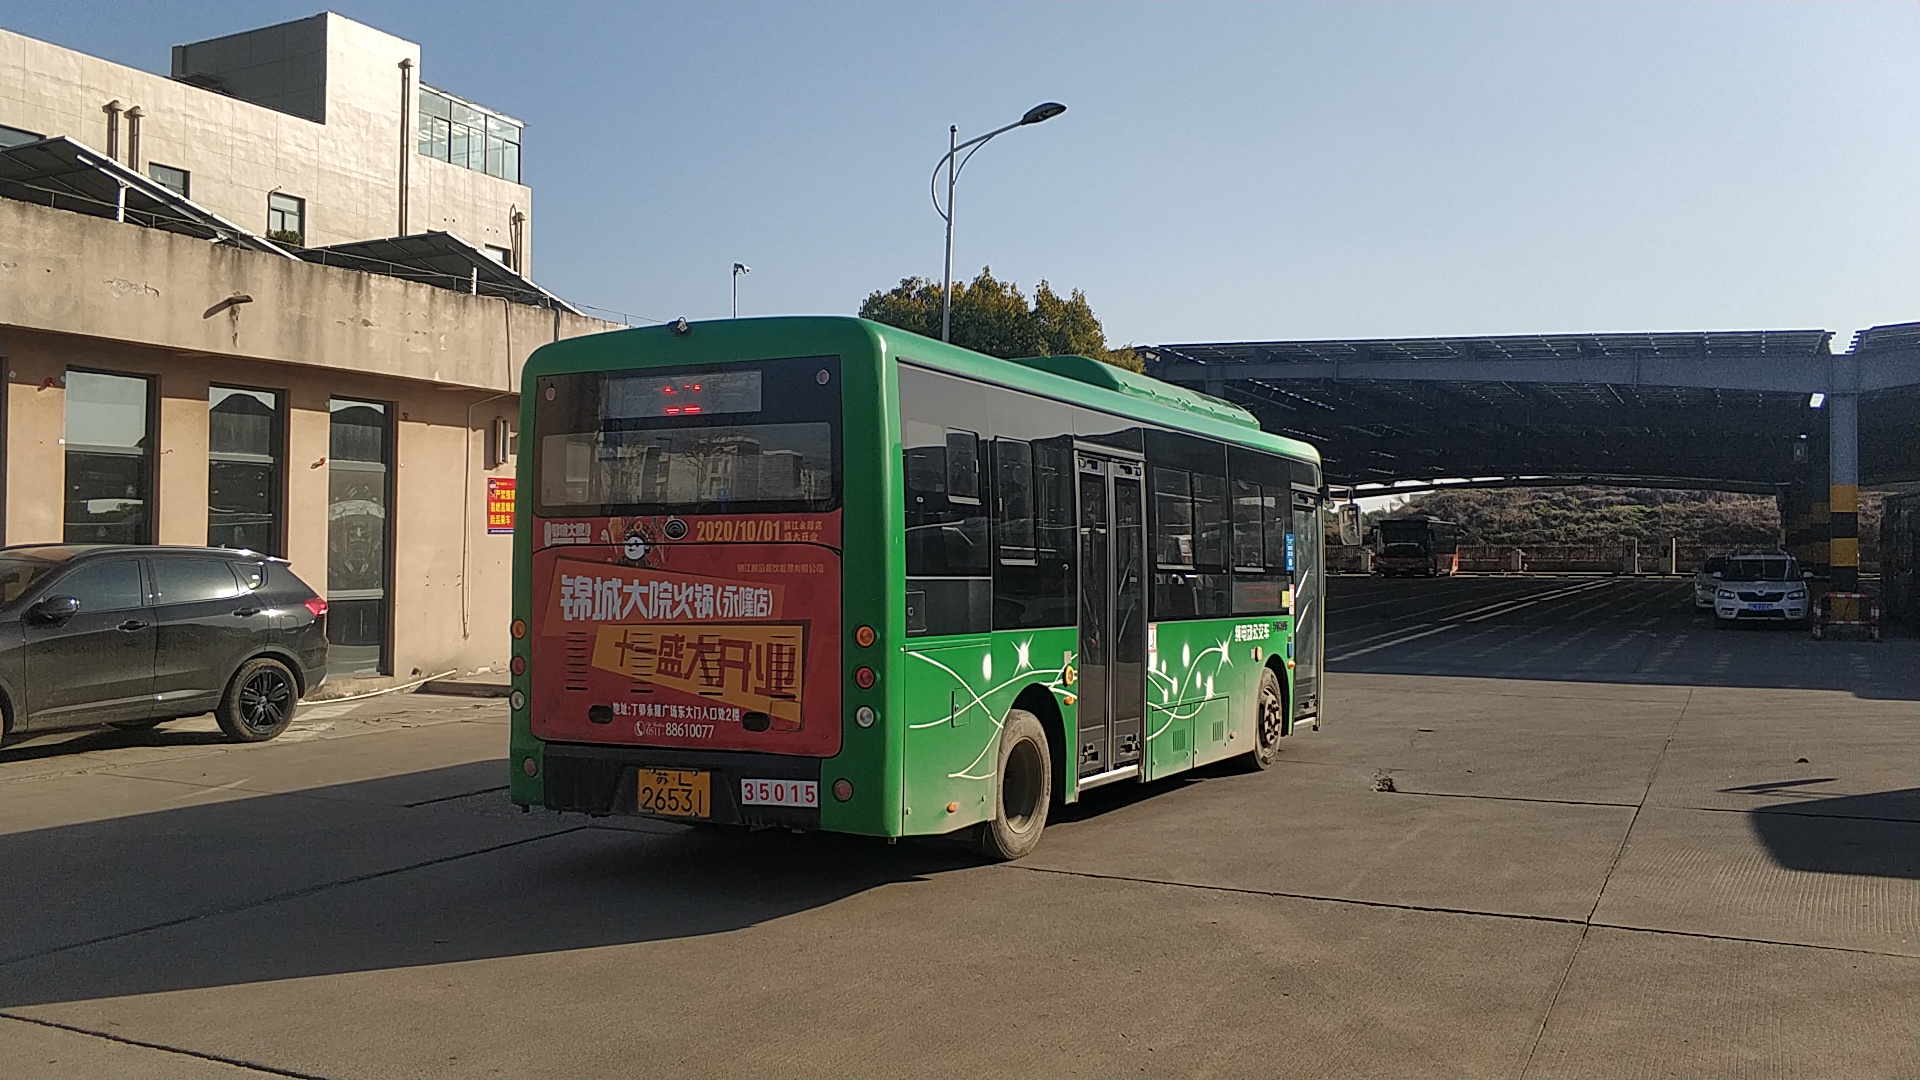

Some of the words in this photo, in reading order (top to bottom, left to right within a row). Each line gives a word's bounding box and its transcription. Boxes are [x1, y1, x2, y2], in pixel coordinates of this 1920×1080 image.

[696, 520, 780, 542] 2020/10/01
[641, 786, 703, 814] 26531
[744, 782, 815, 803] 35015
